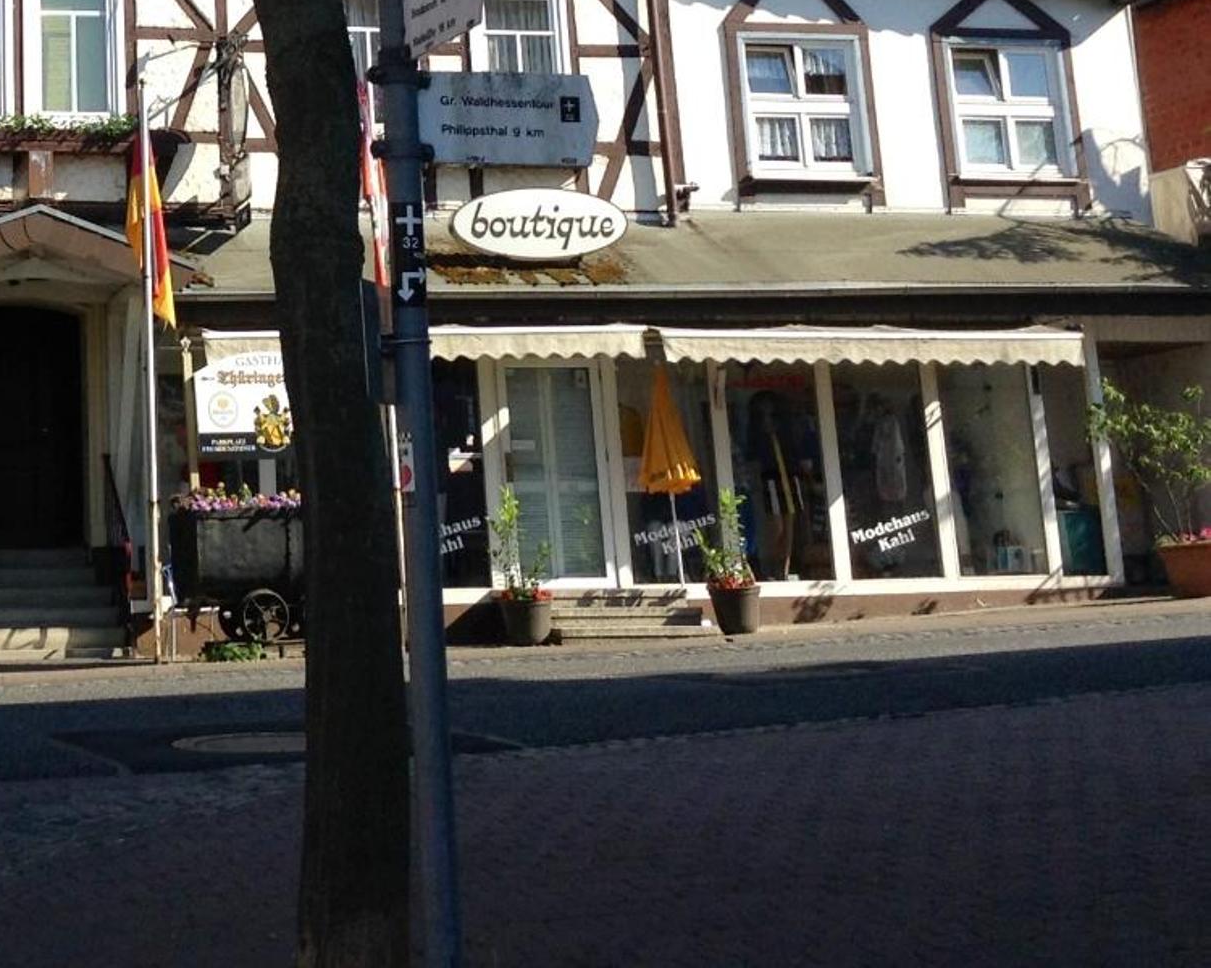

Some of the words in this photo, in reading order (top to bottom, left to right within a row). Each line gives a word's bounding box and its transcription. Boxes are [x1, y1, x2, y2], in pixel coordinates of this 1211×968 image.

[440, 95, 457, 107] Gr.
[461, 96, 554, 110] Waldhessentour
[441, 123, 508, 138] Philippsthal
[512, 124, 520, 137] 9
[526, 127, 545, 138] km
[471, 202, 615, 250] boutique
[402, 237, 419, 249] 32
[216, 370, 285, 389] Thüringe
[850, 509, 930, 544] Modehaus
[440, 535, 465, 554] ahl
[877, 527, 915, 552] Kahl
